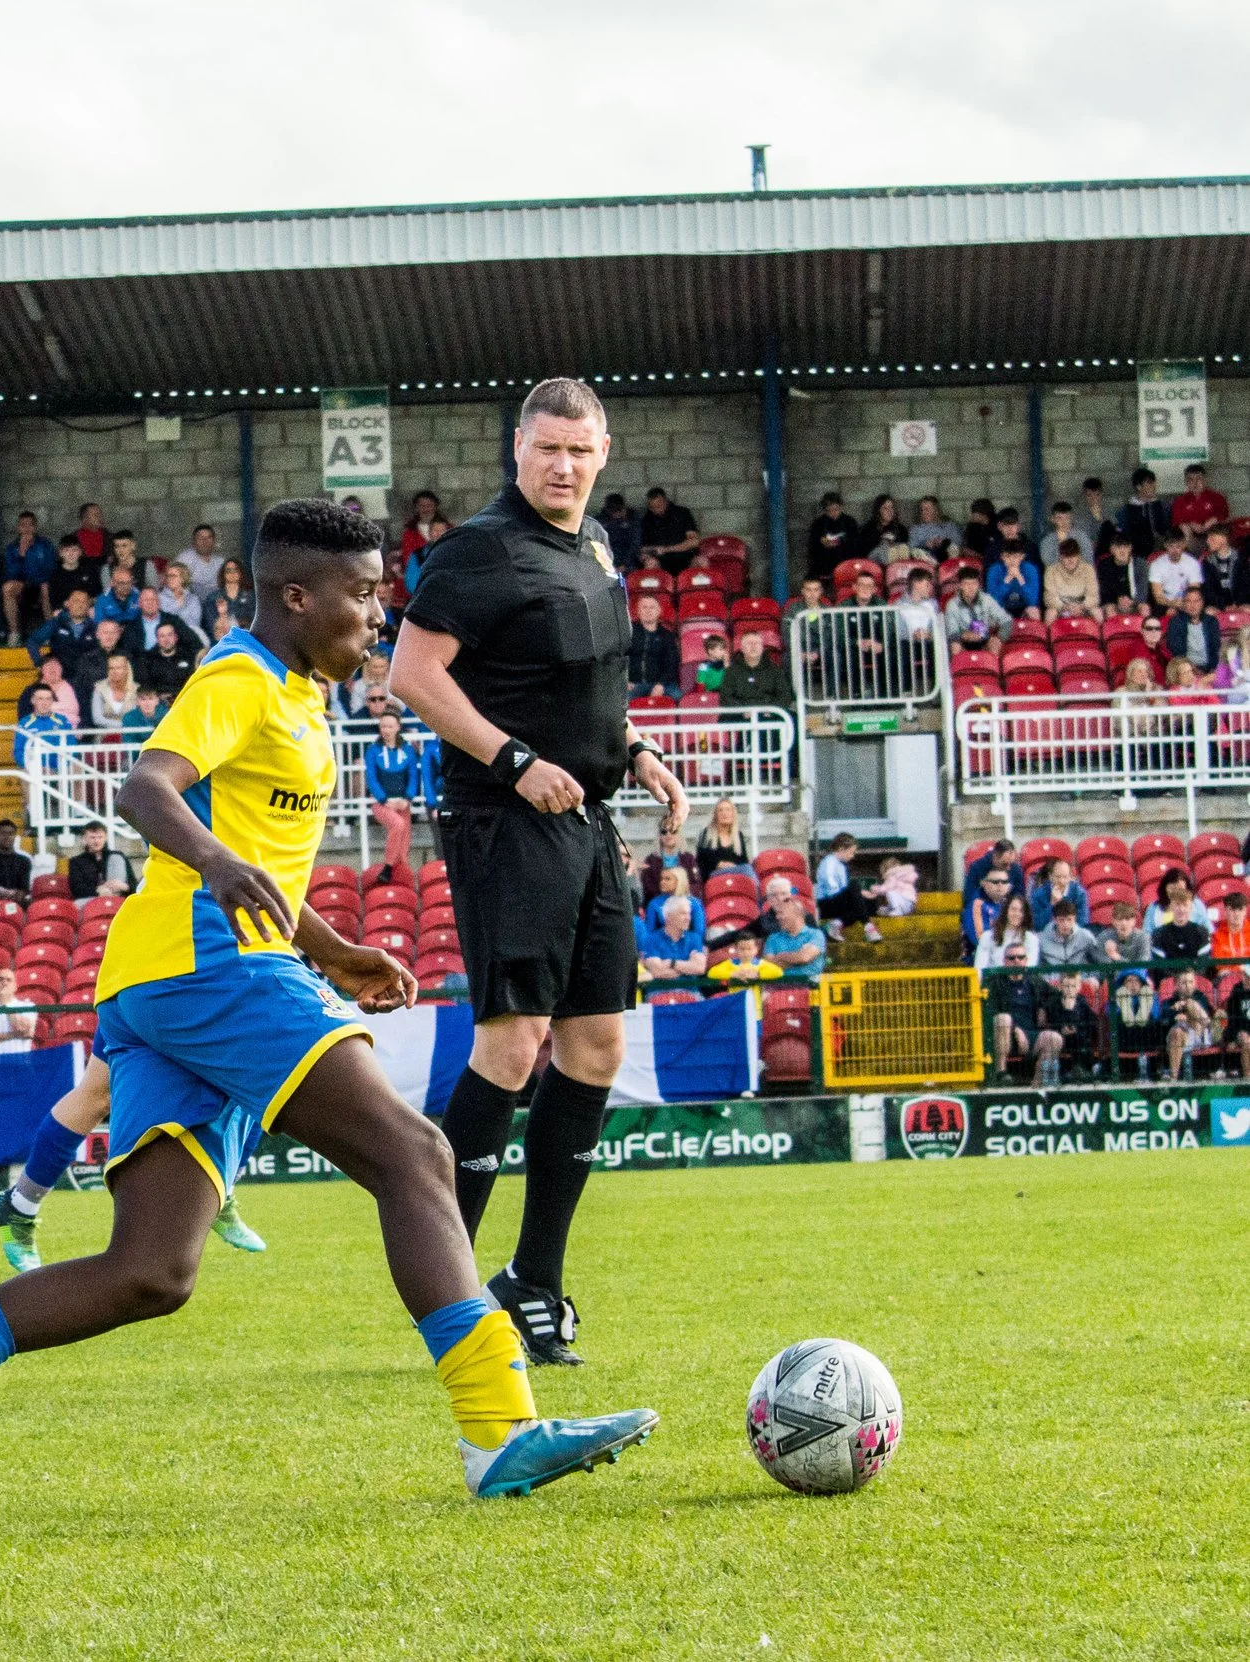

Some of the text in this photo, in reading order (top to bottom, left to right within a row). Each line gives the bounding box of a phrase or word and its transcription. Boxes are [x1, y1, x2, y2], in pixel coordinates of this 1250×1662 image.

[1144, 388, 1200, 402] BLOCK
[327, 416, 384, 430] BLOCK
[1145, 406, 1195, 438] B1
[327, 435, 384, 467] A3
[984, 1098, 1199, 1128] FOLLOW US ON
[984, 1129, 1200, 1158] SOCIAL MEDIA
[813, 1357, 840, 1401] mitre
